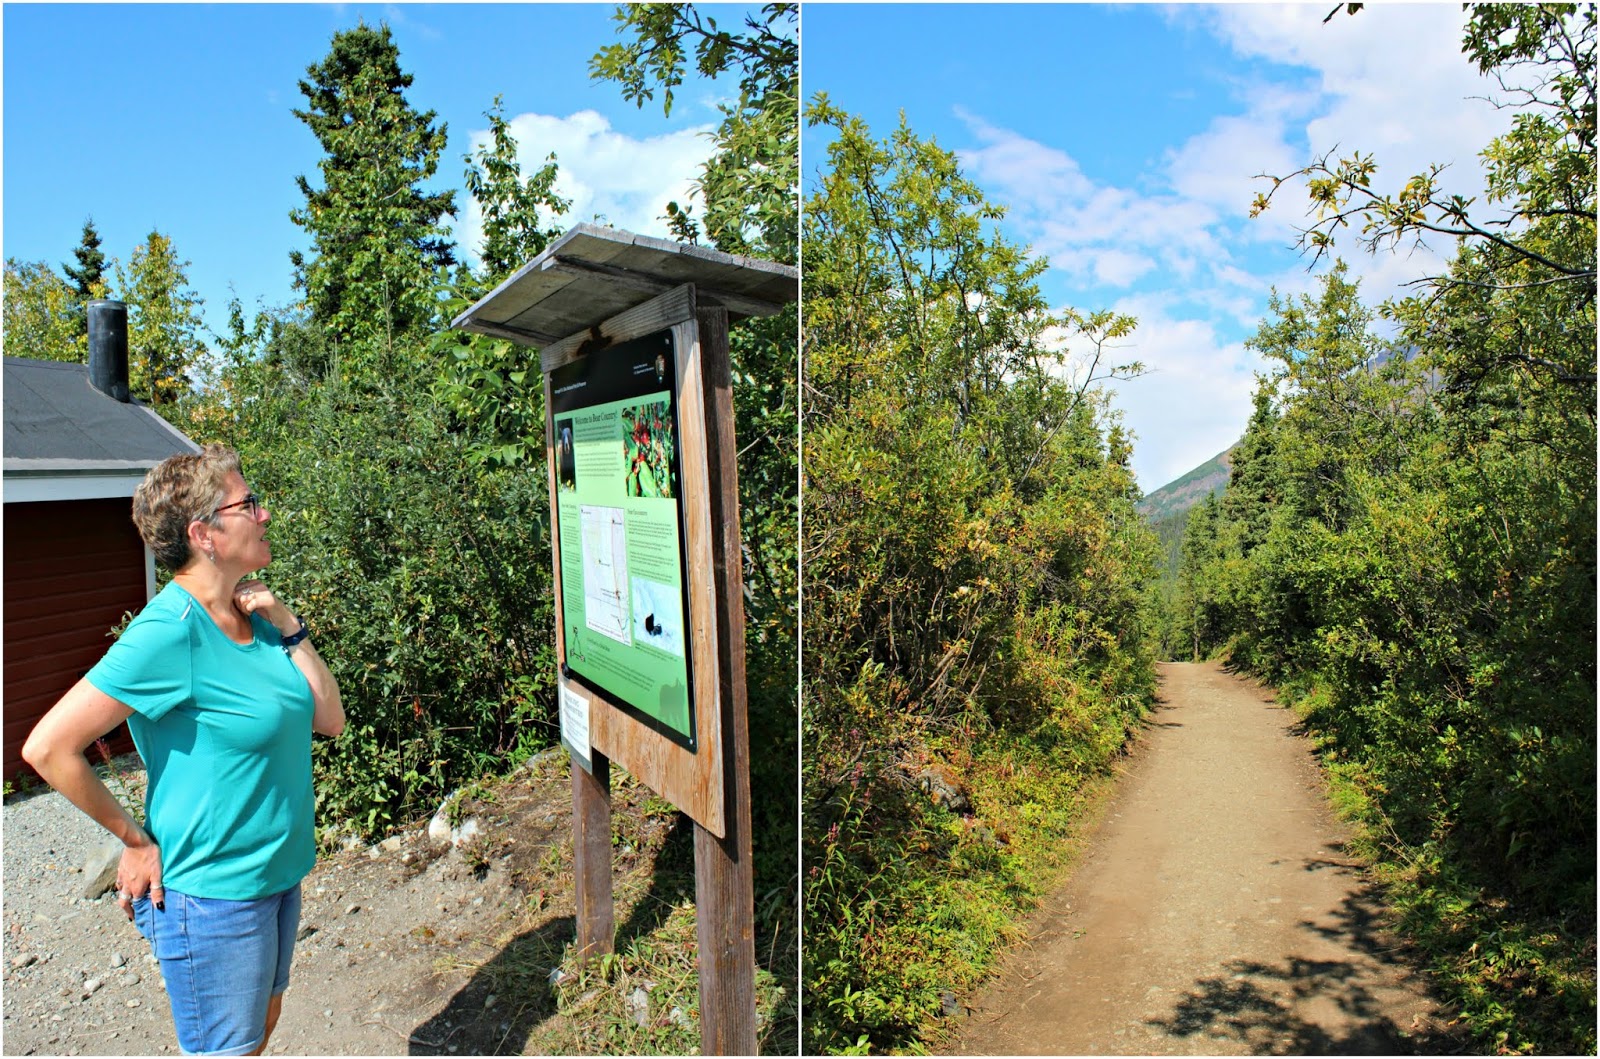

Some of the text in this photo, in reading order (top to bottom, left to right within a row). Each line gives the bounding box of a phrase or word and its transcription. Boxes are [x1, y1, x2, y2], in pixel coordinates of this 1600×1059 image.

[575, 416, 588, 424] Welcome
[592, 413, 601, 422] Bear
[601, 410, 617, 421] Country!
